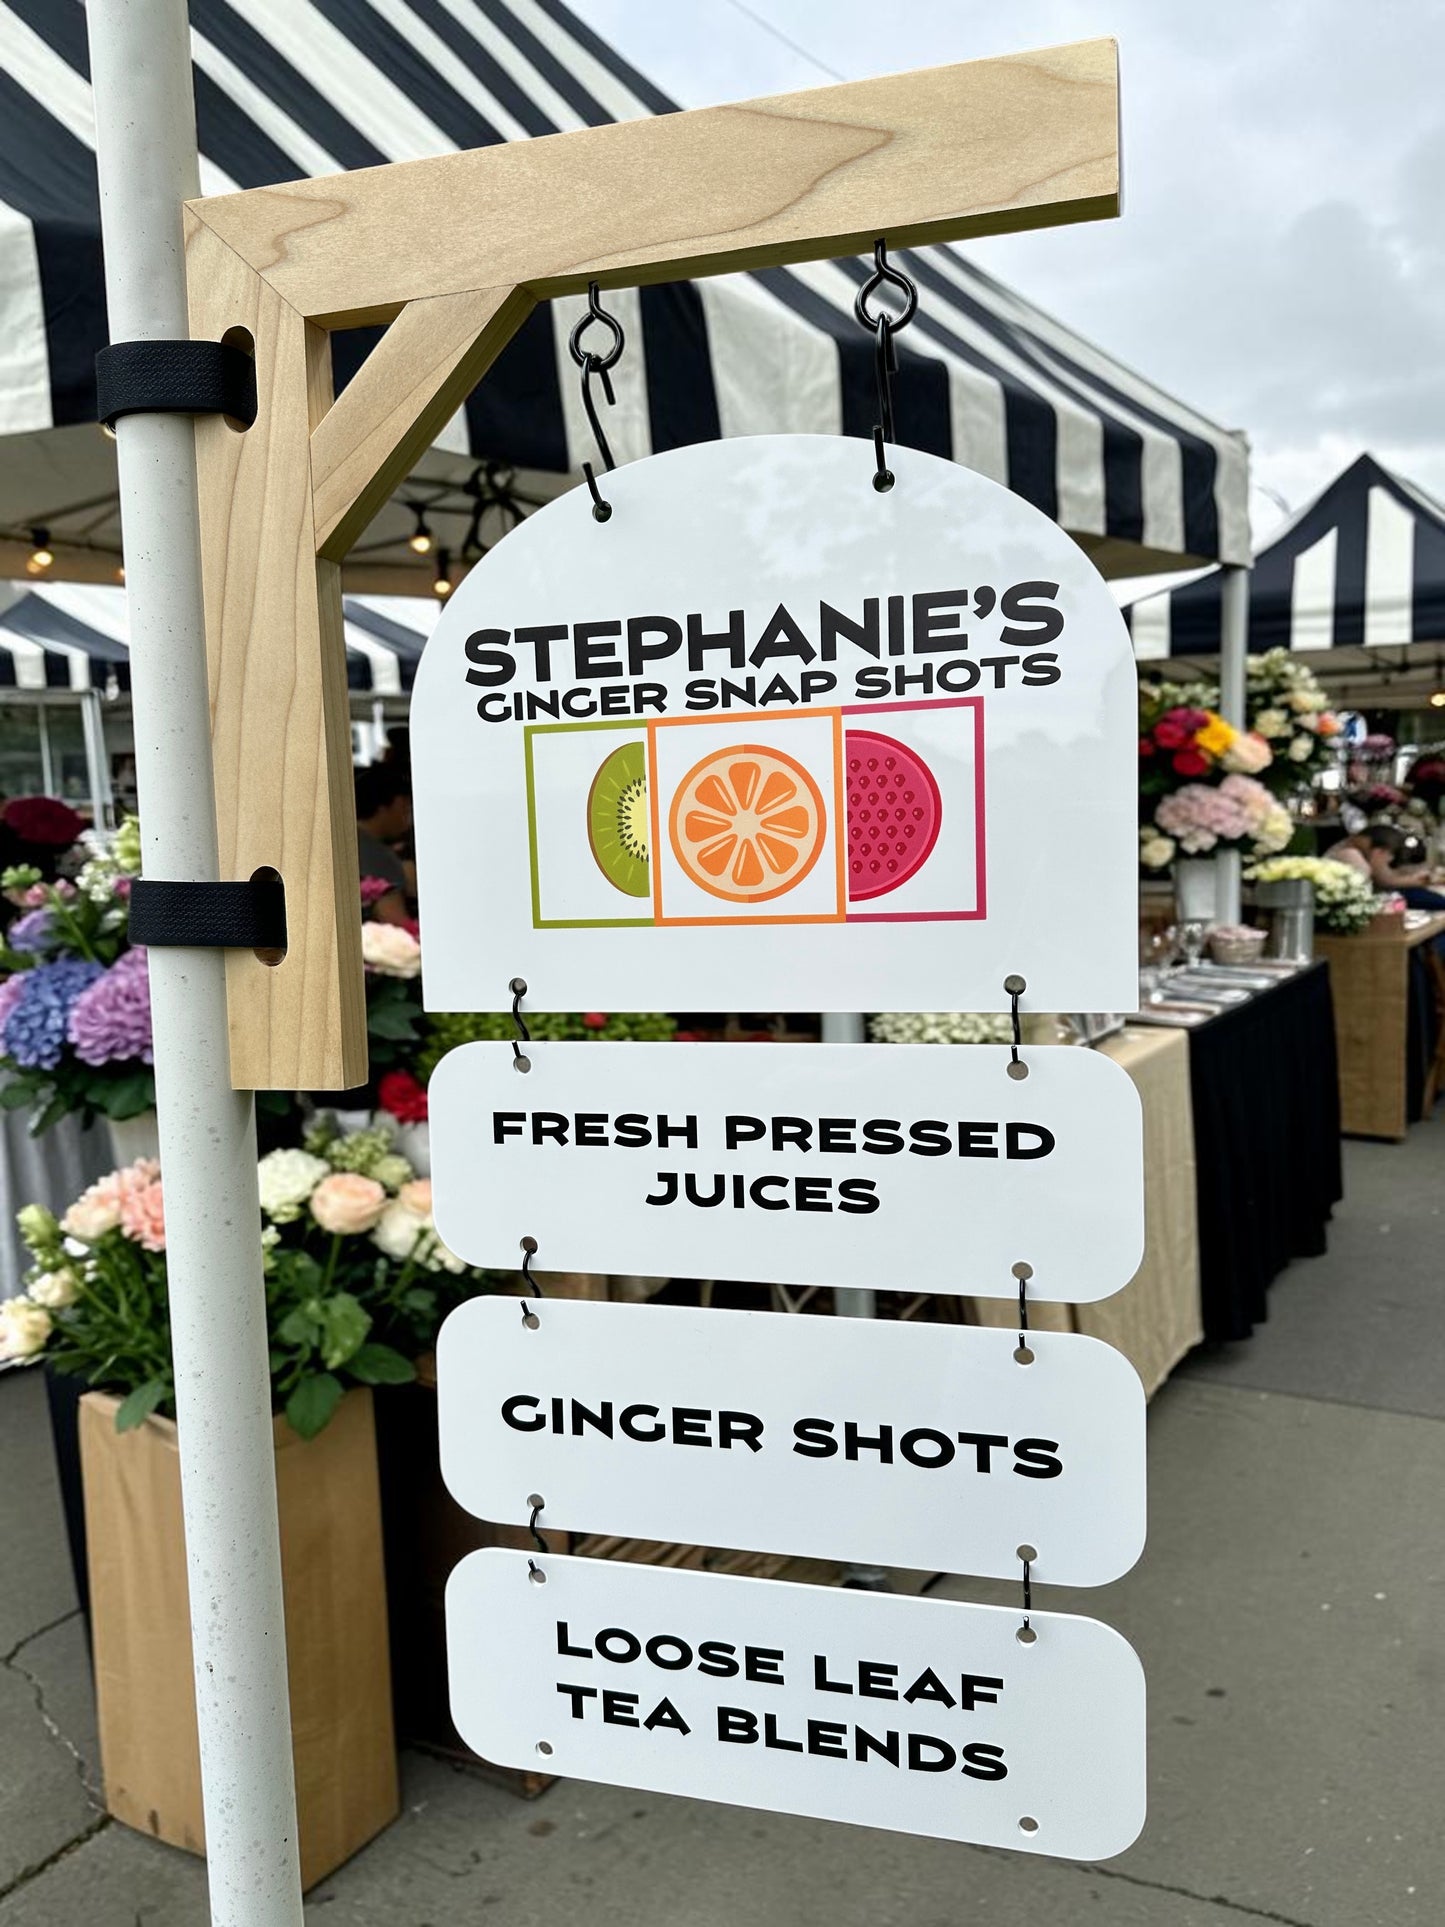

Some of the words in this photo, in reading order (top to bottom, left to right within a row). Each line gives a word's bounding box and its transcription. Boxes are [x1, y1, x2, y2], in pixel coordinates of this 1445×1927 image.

[464, 580, 1065, 687] STEPHANIE'S
[476, 678, 668, 723] GINGER
[684, 670, 838, 711] SNAP
[854, 652, 1062, 699] SHOTS
[492, 1111, 698, 1149] FRESH
[725, 1115, 1056, 1160] PRESSED
[645, 1172, 880, 1215] JUICES
[501, 1394, 764, 1453] GINGER
[792, 1417, 1063, 1479] SHOTS
[556, 1620, 785, 1686] LOOSE
[814, 1654, 1004, 1712] LEAF
[556, 1682, 692, 1736] TEA
[717, 1706, 1008, 1782] BLENDS
